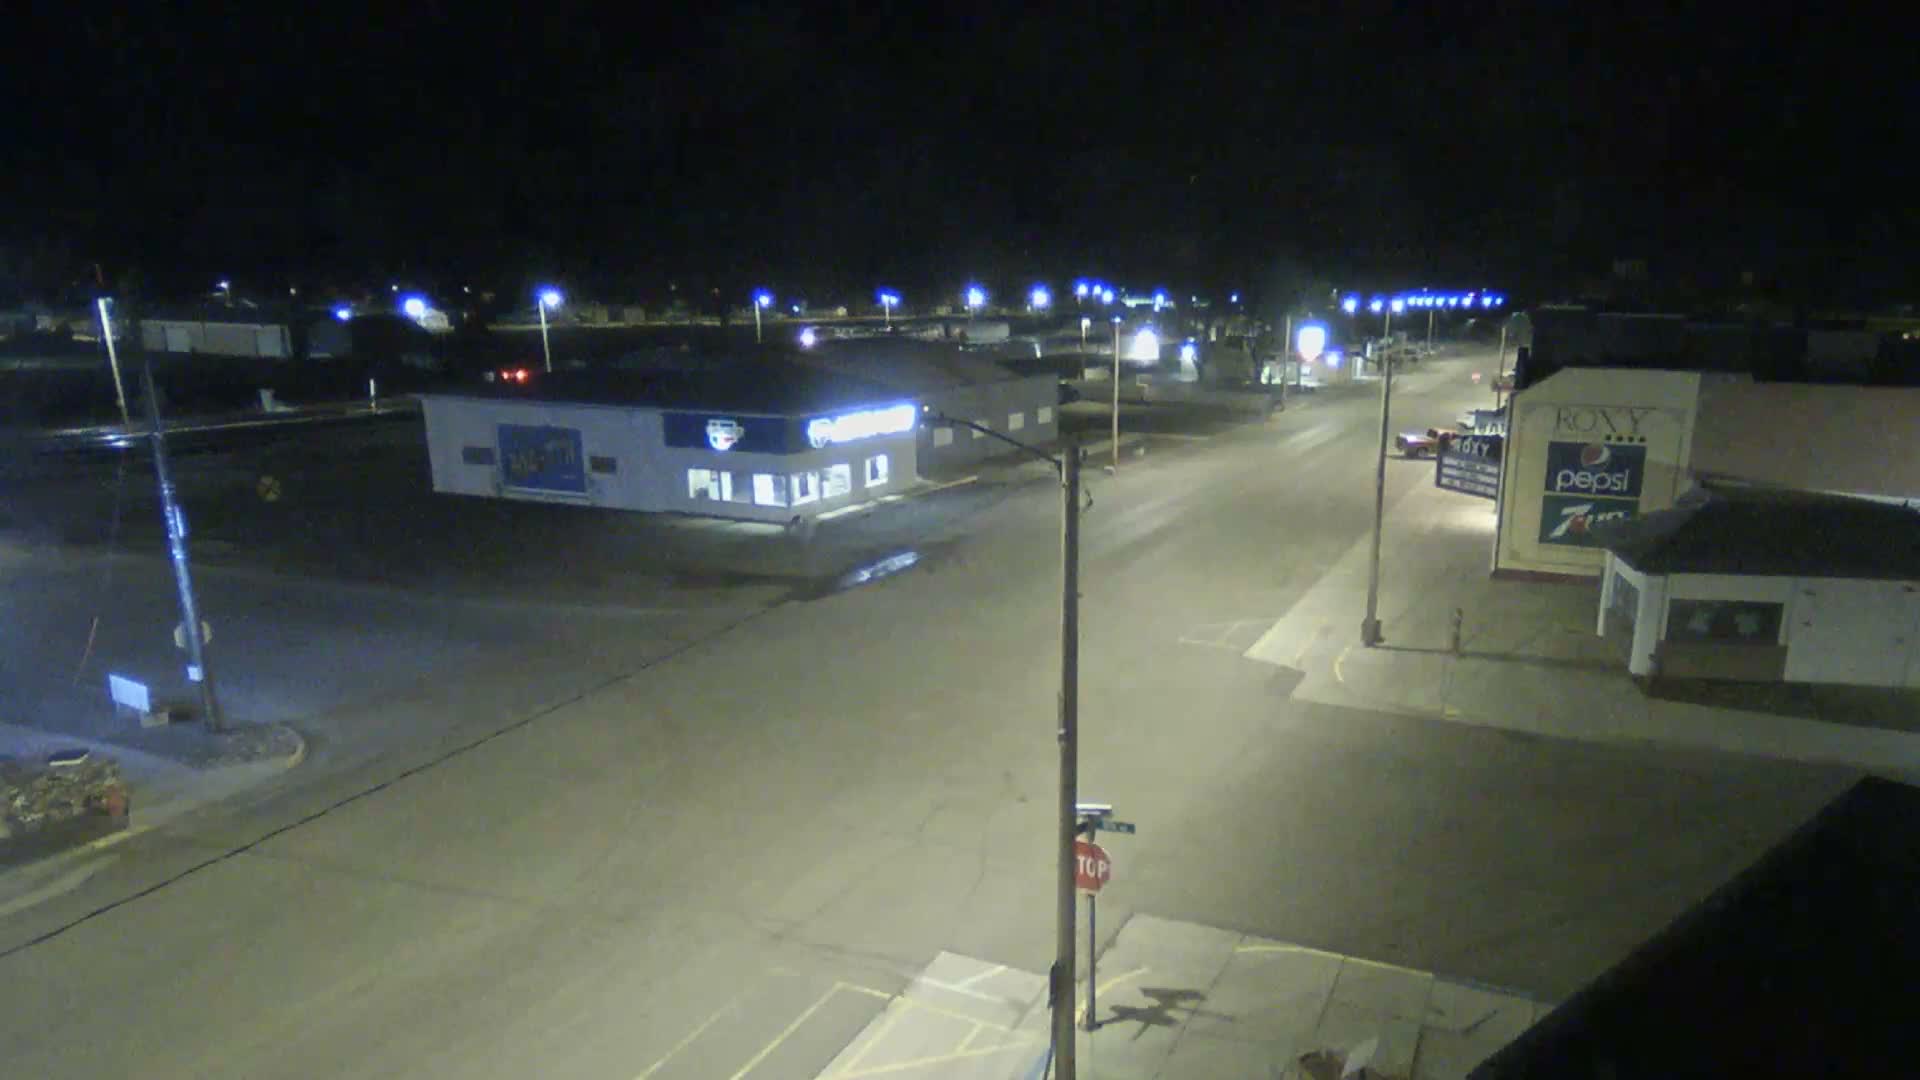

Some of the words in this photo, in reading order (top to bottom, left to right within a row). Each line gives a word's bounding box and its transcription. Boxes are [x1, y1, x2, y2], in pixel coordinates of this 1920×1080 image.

[1555, 407, 1649, 433] ROXY
[1555, 468, 1630, 492] pepsi
[1077, 855, 1107, 879] TOP
